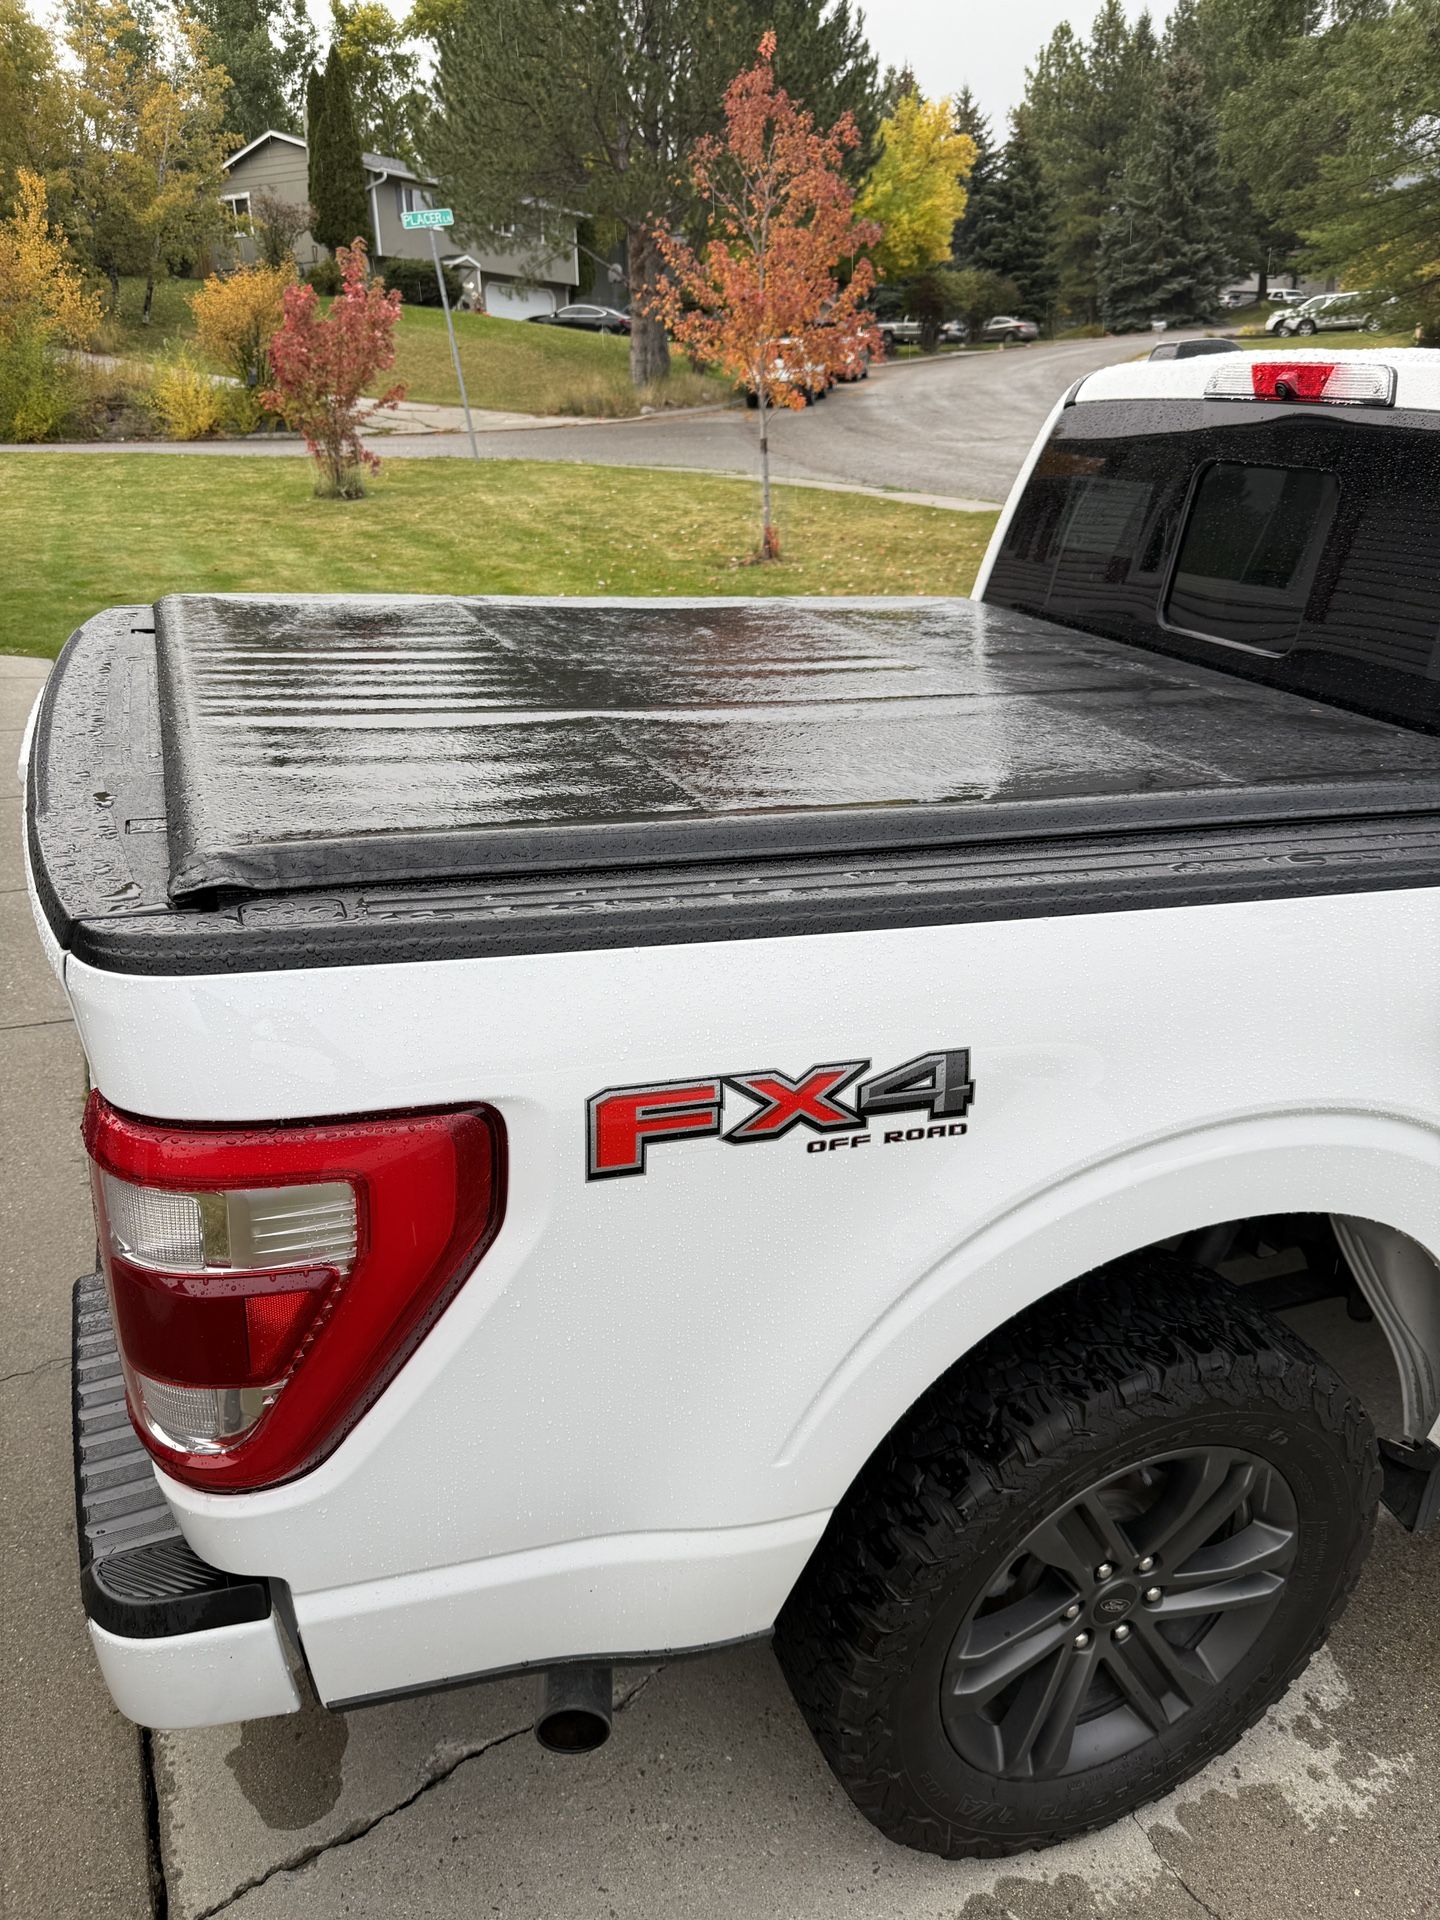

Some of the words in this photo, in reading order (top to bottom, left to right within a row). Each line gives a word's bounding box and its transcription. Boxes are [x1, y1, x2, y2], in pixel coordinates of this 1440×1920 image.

[403, 213, 442, 226] PLACER
[585, 1046, 976, 1183] FX4
[806, 1134, 871, 1154] OFF
[883, 1122, 968, 1145] ROAD
